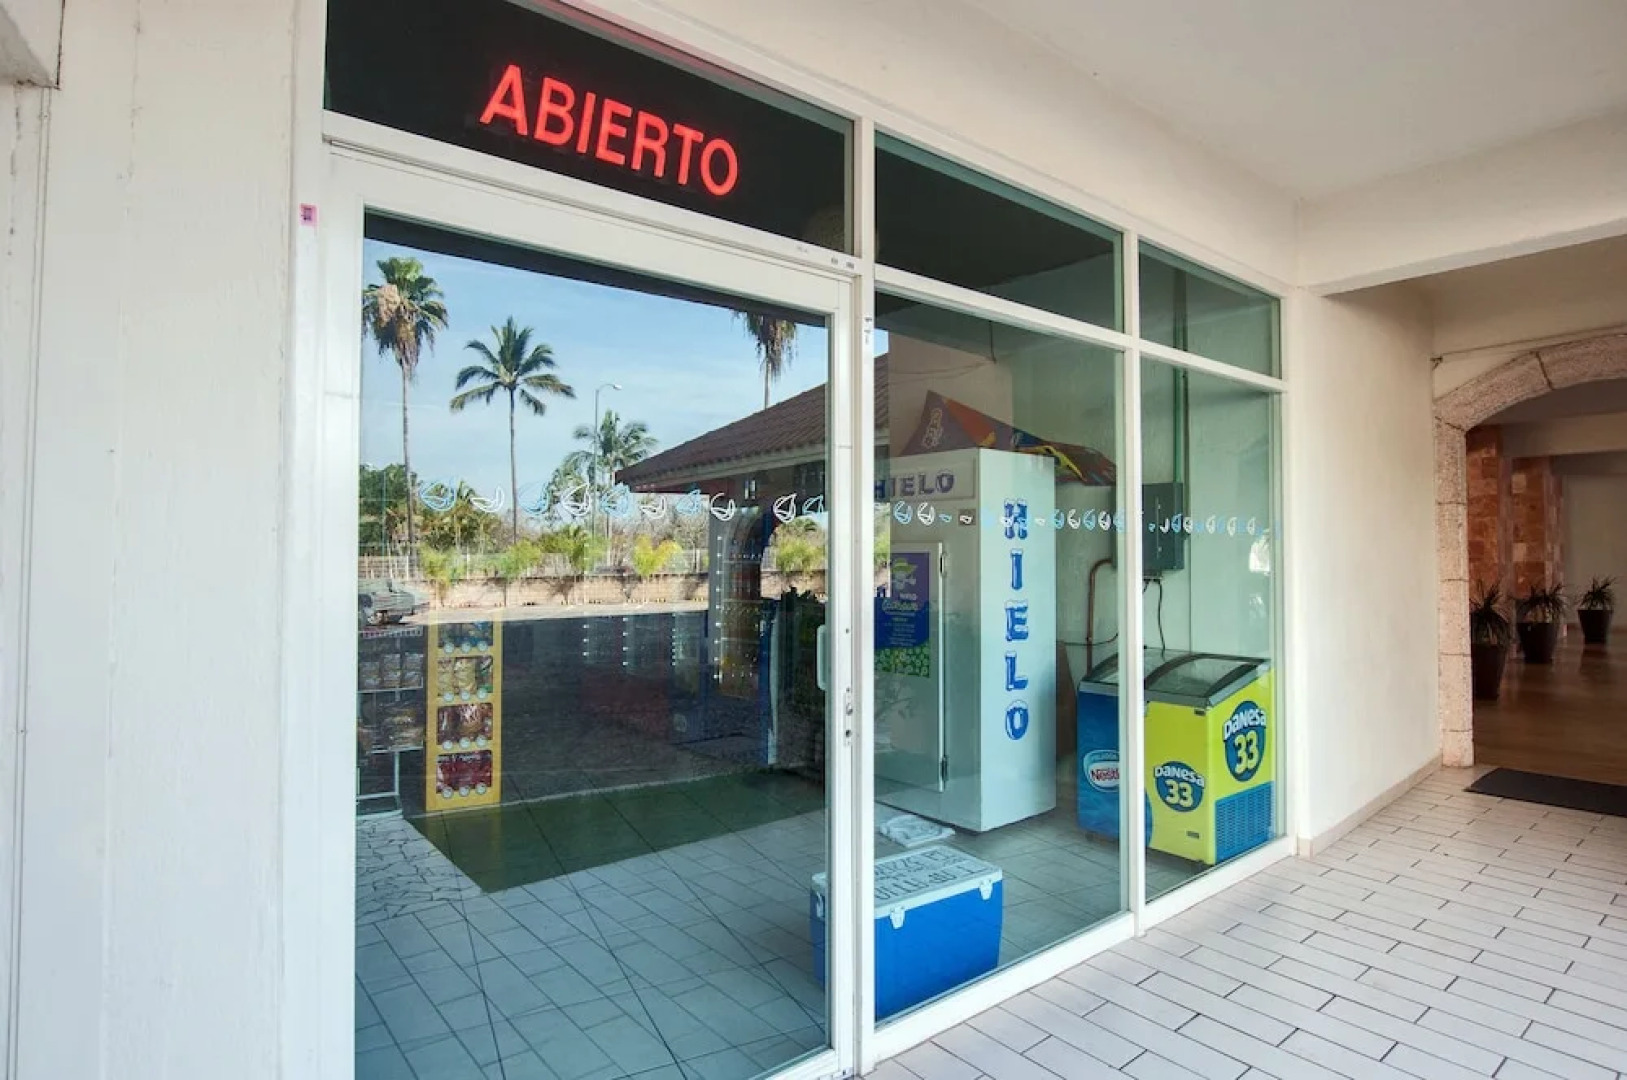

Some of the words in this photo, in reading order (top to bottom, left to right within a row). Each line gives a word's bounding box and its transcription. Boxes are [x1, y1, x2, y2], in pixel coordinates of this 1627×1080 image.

[480, 64, 739, 196] ABIERTO
[1003, 498, 1029, 740] HIELO
[1091, 767, 1120, 781] Nestl
[1234, 729, 1259, 774] 33
[1165, 778, 1194, 808] 33
